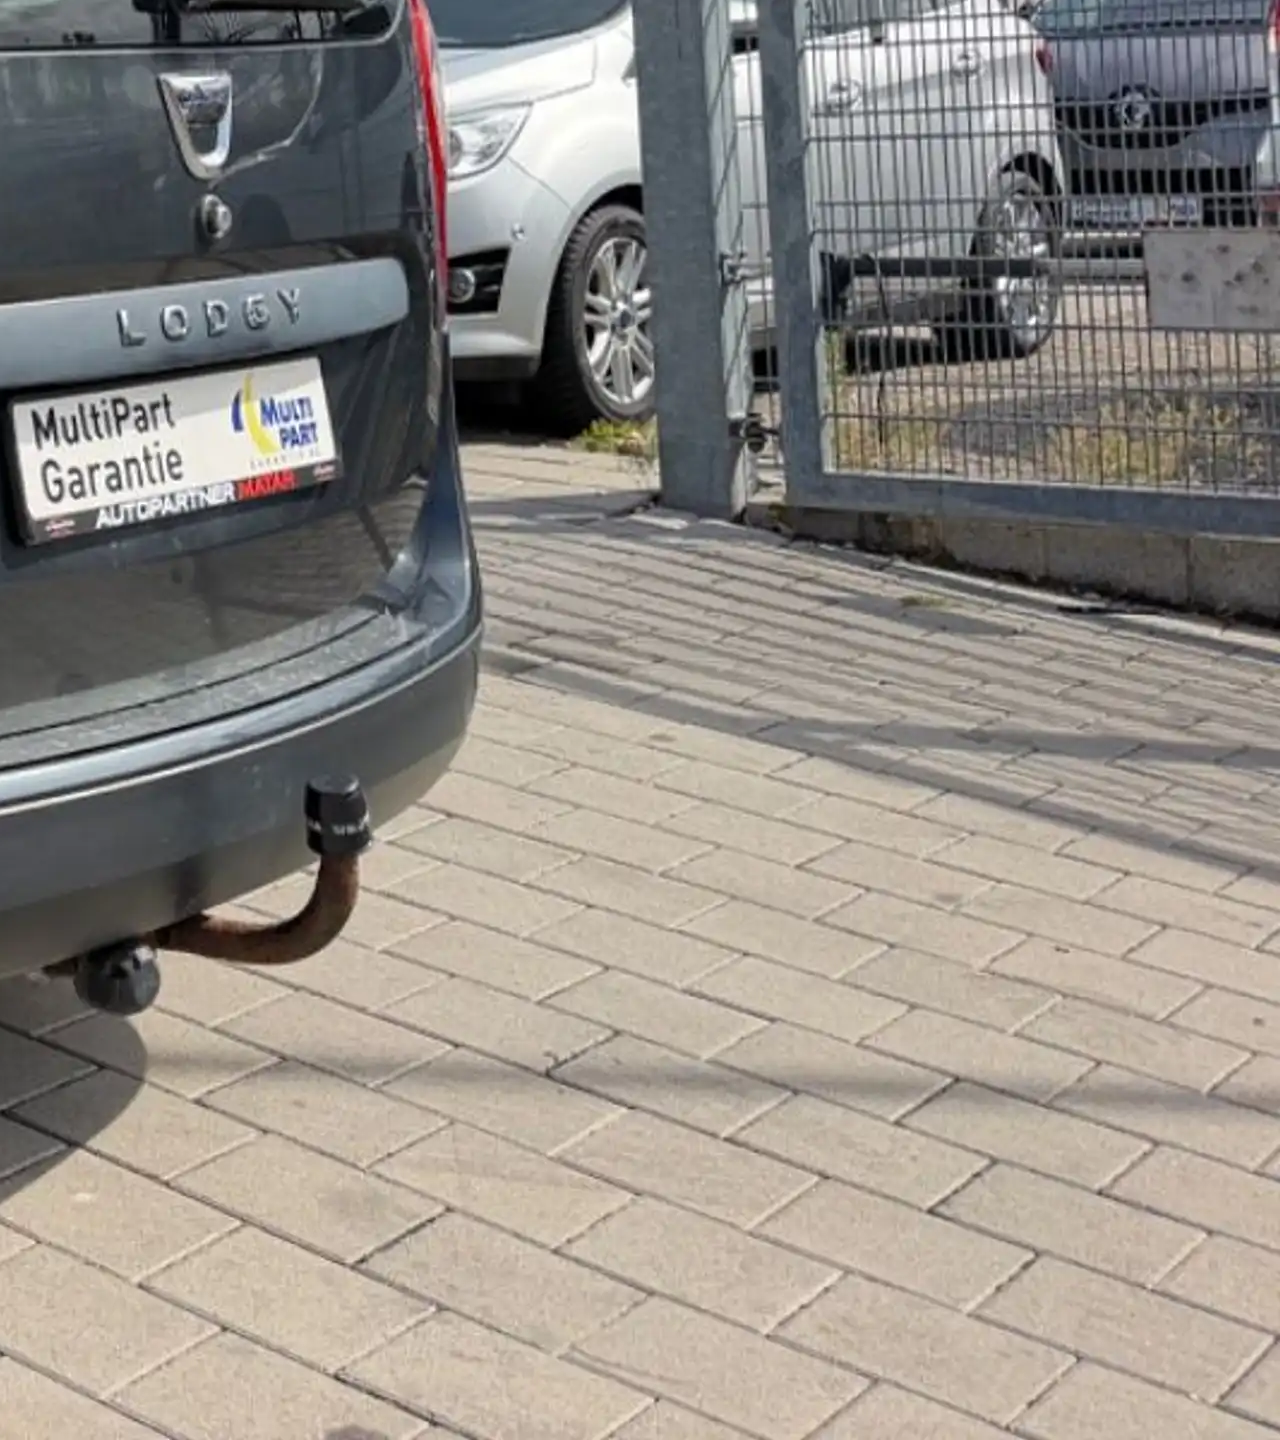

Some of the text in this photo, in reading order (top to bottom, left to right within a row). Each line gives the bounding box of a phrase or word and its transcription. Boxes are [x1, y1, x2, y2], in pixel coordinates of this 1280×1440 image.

[116, 287, 301, 347] LODGY
[31, 392, 176, 451] MultiPart
[278, 420, 319, 450] PART
[40, 441, 184, 504] Garantie
[94, 481, 236, 529] AUTOPARTNER
